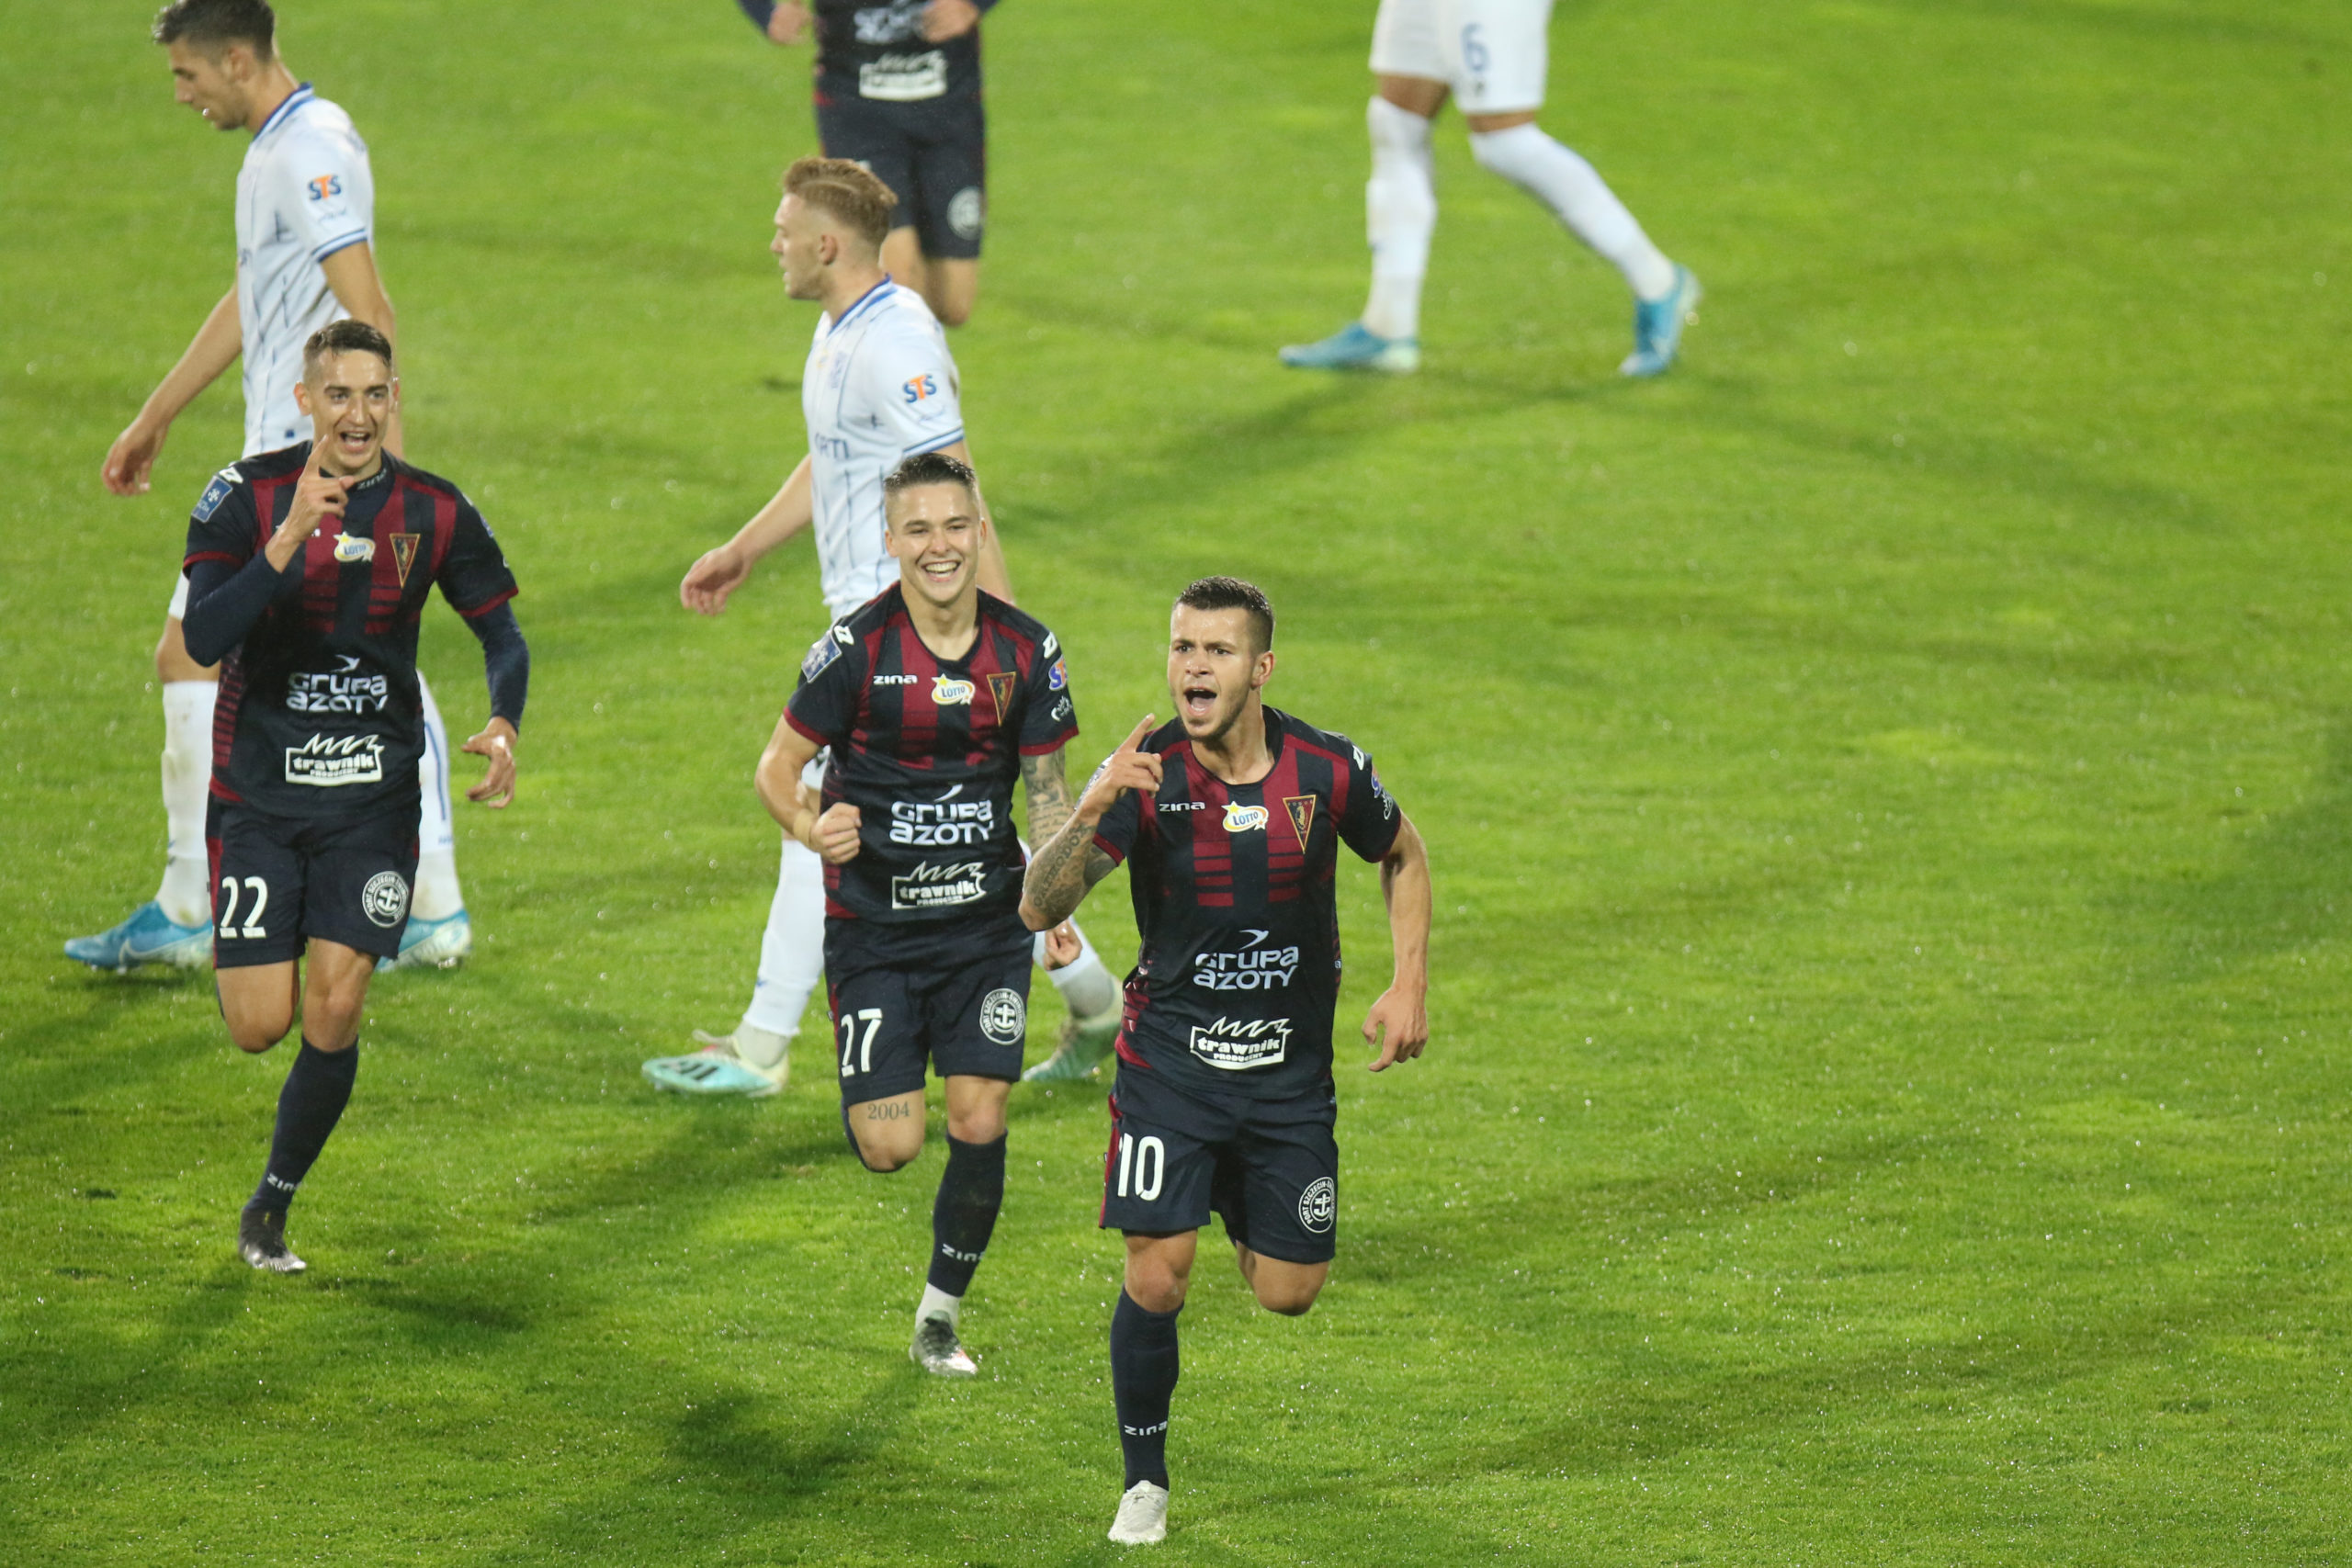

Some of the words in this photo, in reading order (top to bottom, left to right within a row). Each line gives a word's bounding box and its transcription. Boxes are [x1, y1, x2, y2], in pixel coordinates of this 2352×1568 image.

[1460, 21, 1492, 73] 6
[308, 175, 342, 201] STS
[903, 374, 937, 403] STS
[941, 685, 966, 698] LOTTO
[292, 753, 375, 772] trawnik
[1232, 811, 1259, 826] LOTTO
[899, 880, 977, 900] trawnik
[220, 875, 268, 939] 22
[841, 1008, 883, 1077] 27
[1196, 1036, 1280, 1055] trawnik
[867, 1101, 910, 1121] 2004
[1117, 1133, 1165, 1201] 10
[1302, 1206, 1314, 1224] PORT
